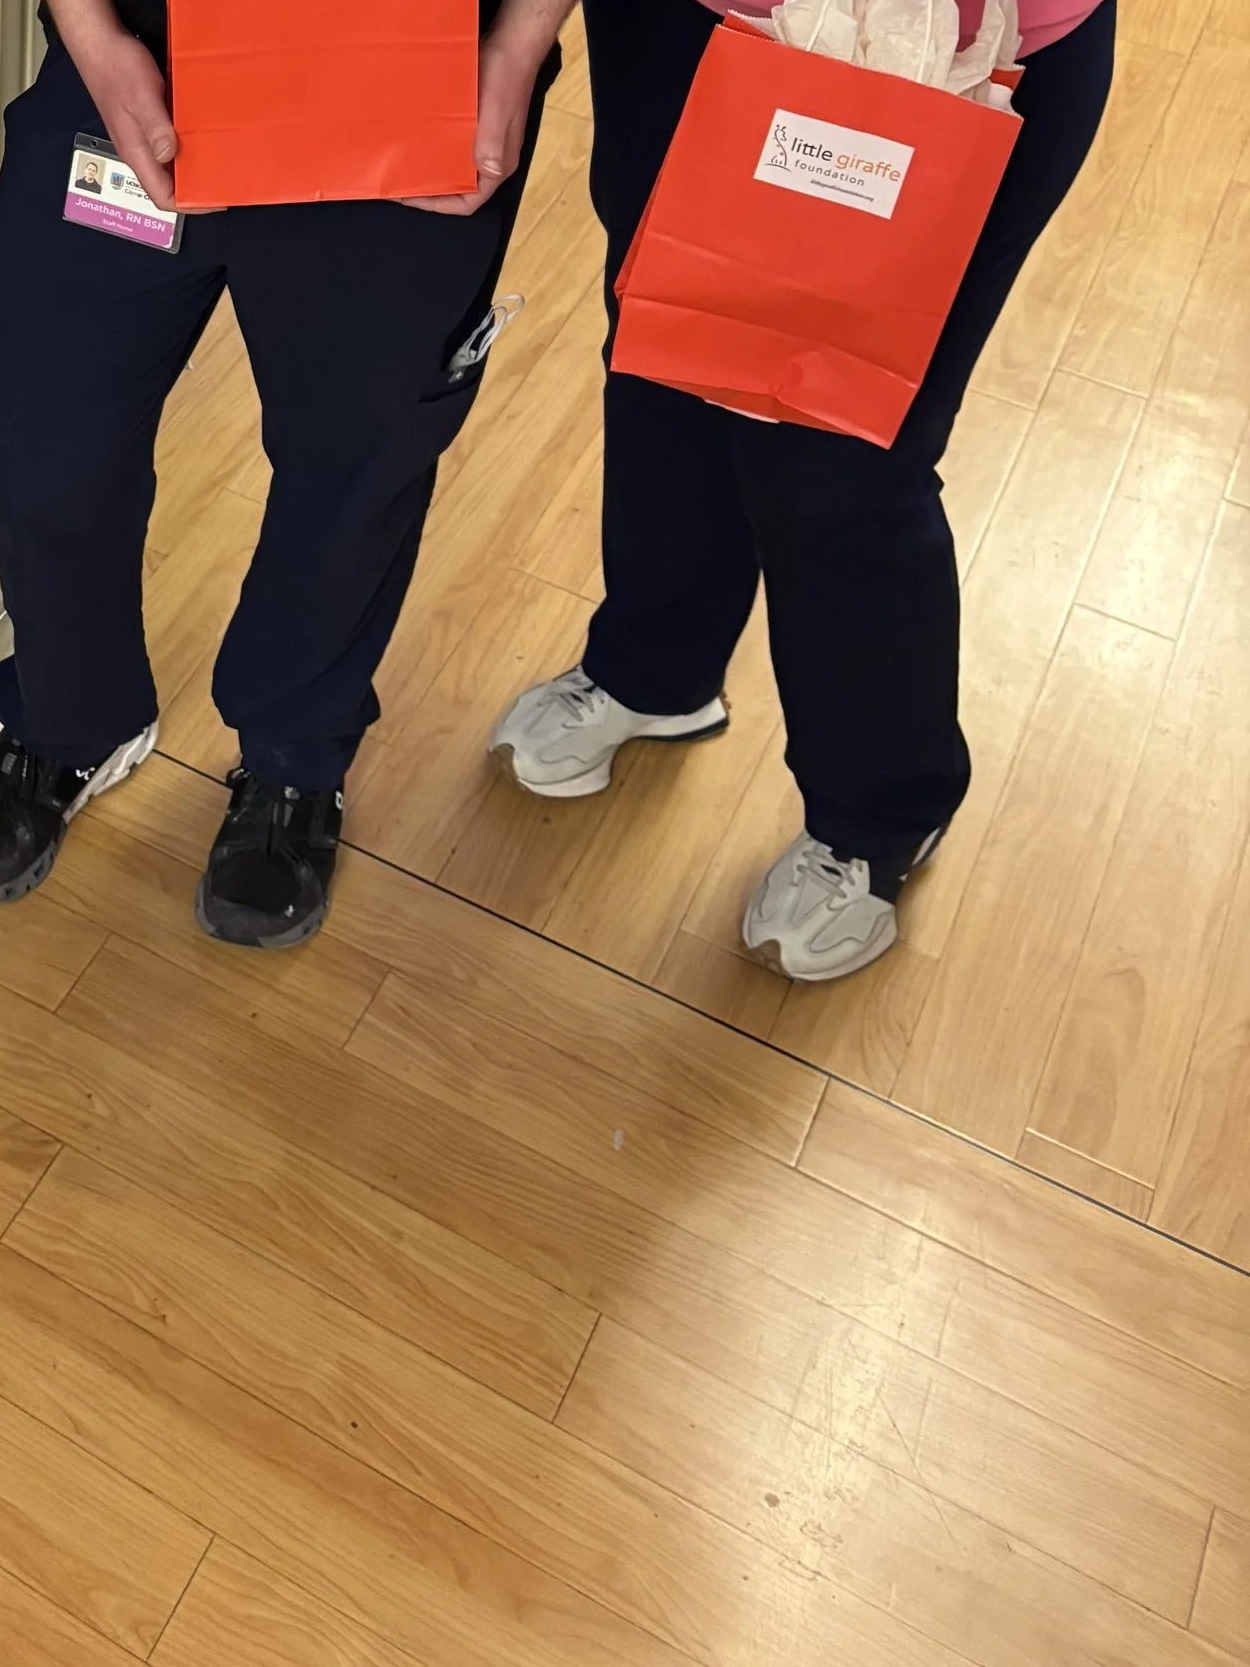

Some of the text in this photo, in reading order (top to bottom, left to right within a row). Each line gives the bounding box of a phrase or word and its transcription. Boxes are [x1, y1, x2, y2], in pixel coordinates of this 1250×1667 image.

[791, 137, 901, 182] little giraffe
[794, 159, 865, 186] foundation
[75, 198, 166, 232] Jonathan, RN BSN
